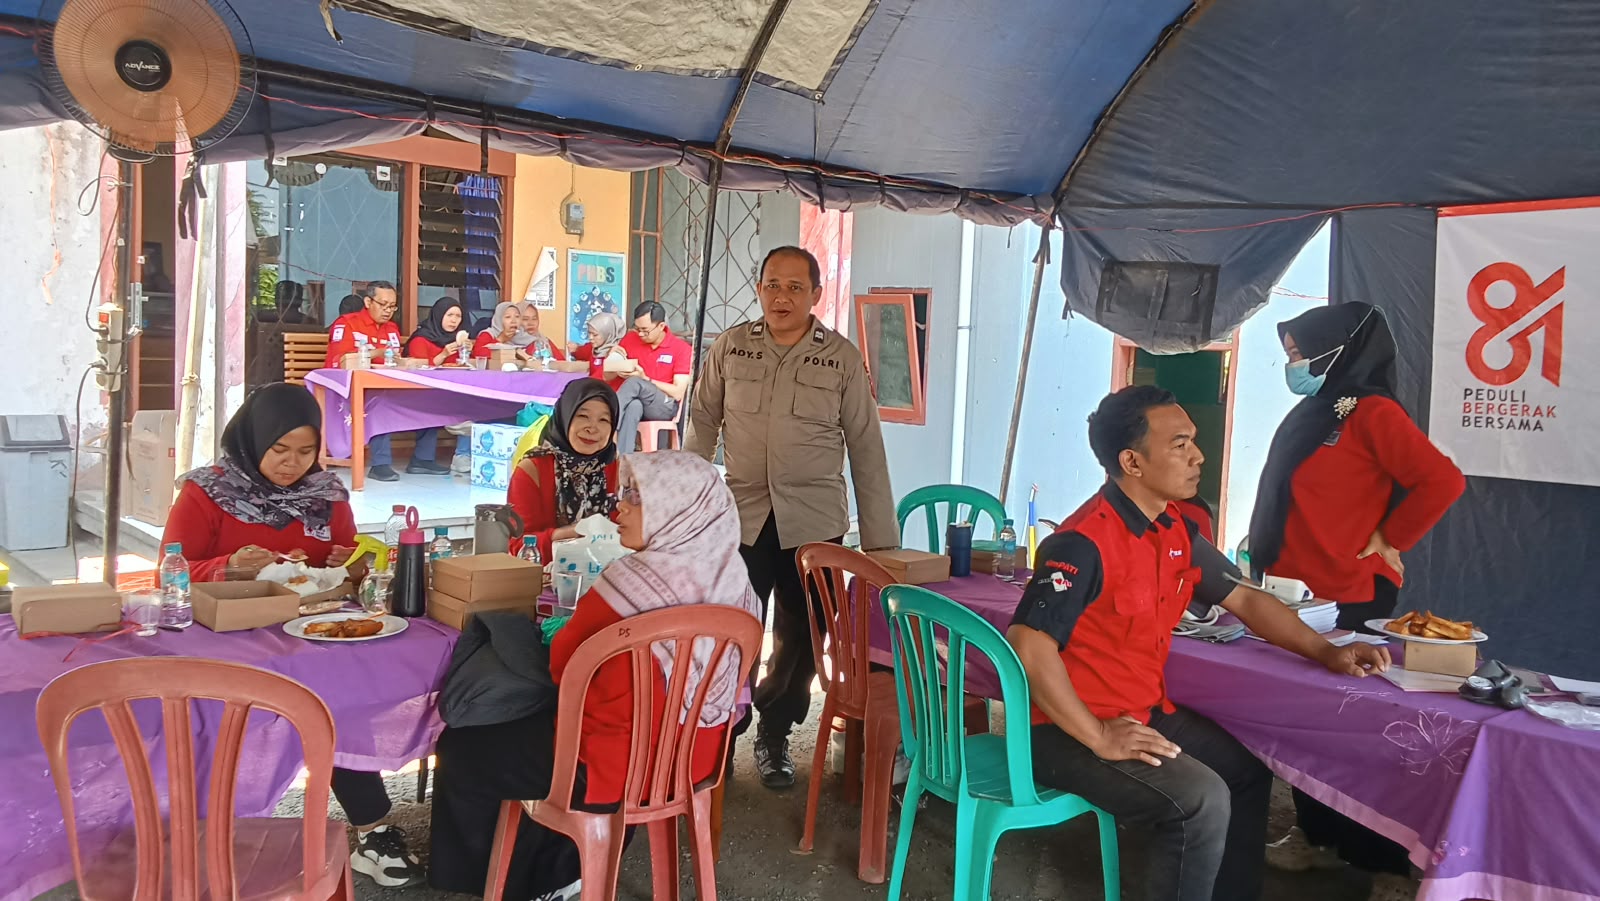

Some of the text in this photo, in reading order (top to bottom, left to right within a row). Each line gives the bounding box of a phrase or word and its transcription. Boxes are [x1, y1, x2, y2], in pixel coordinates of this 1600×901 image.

[124, 61, 161, 71] ADVANCE
[803, 356, 840, 370] POLRI
[1463, 388, 1527, 404] PEDULI
[1462, 402, 1558, 418] BERGERAK
[1461, 415, 1545, 432] BERSAMA
